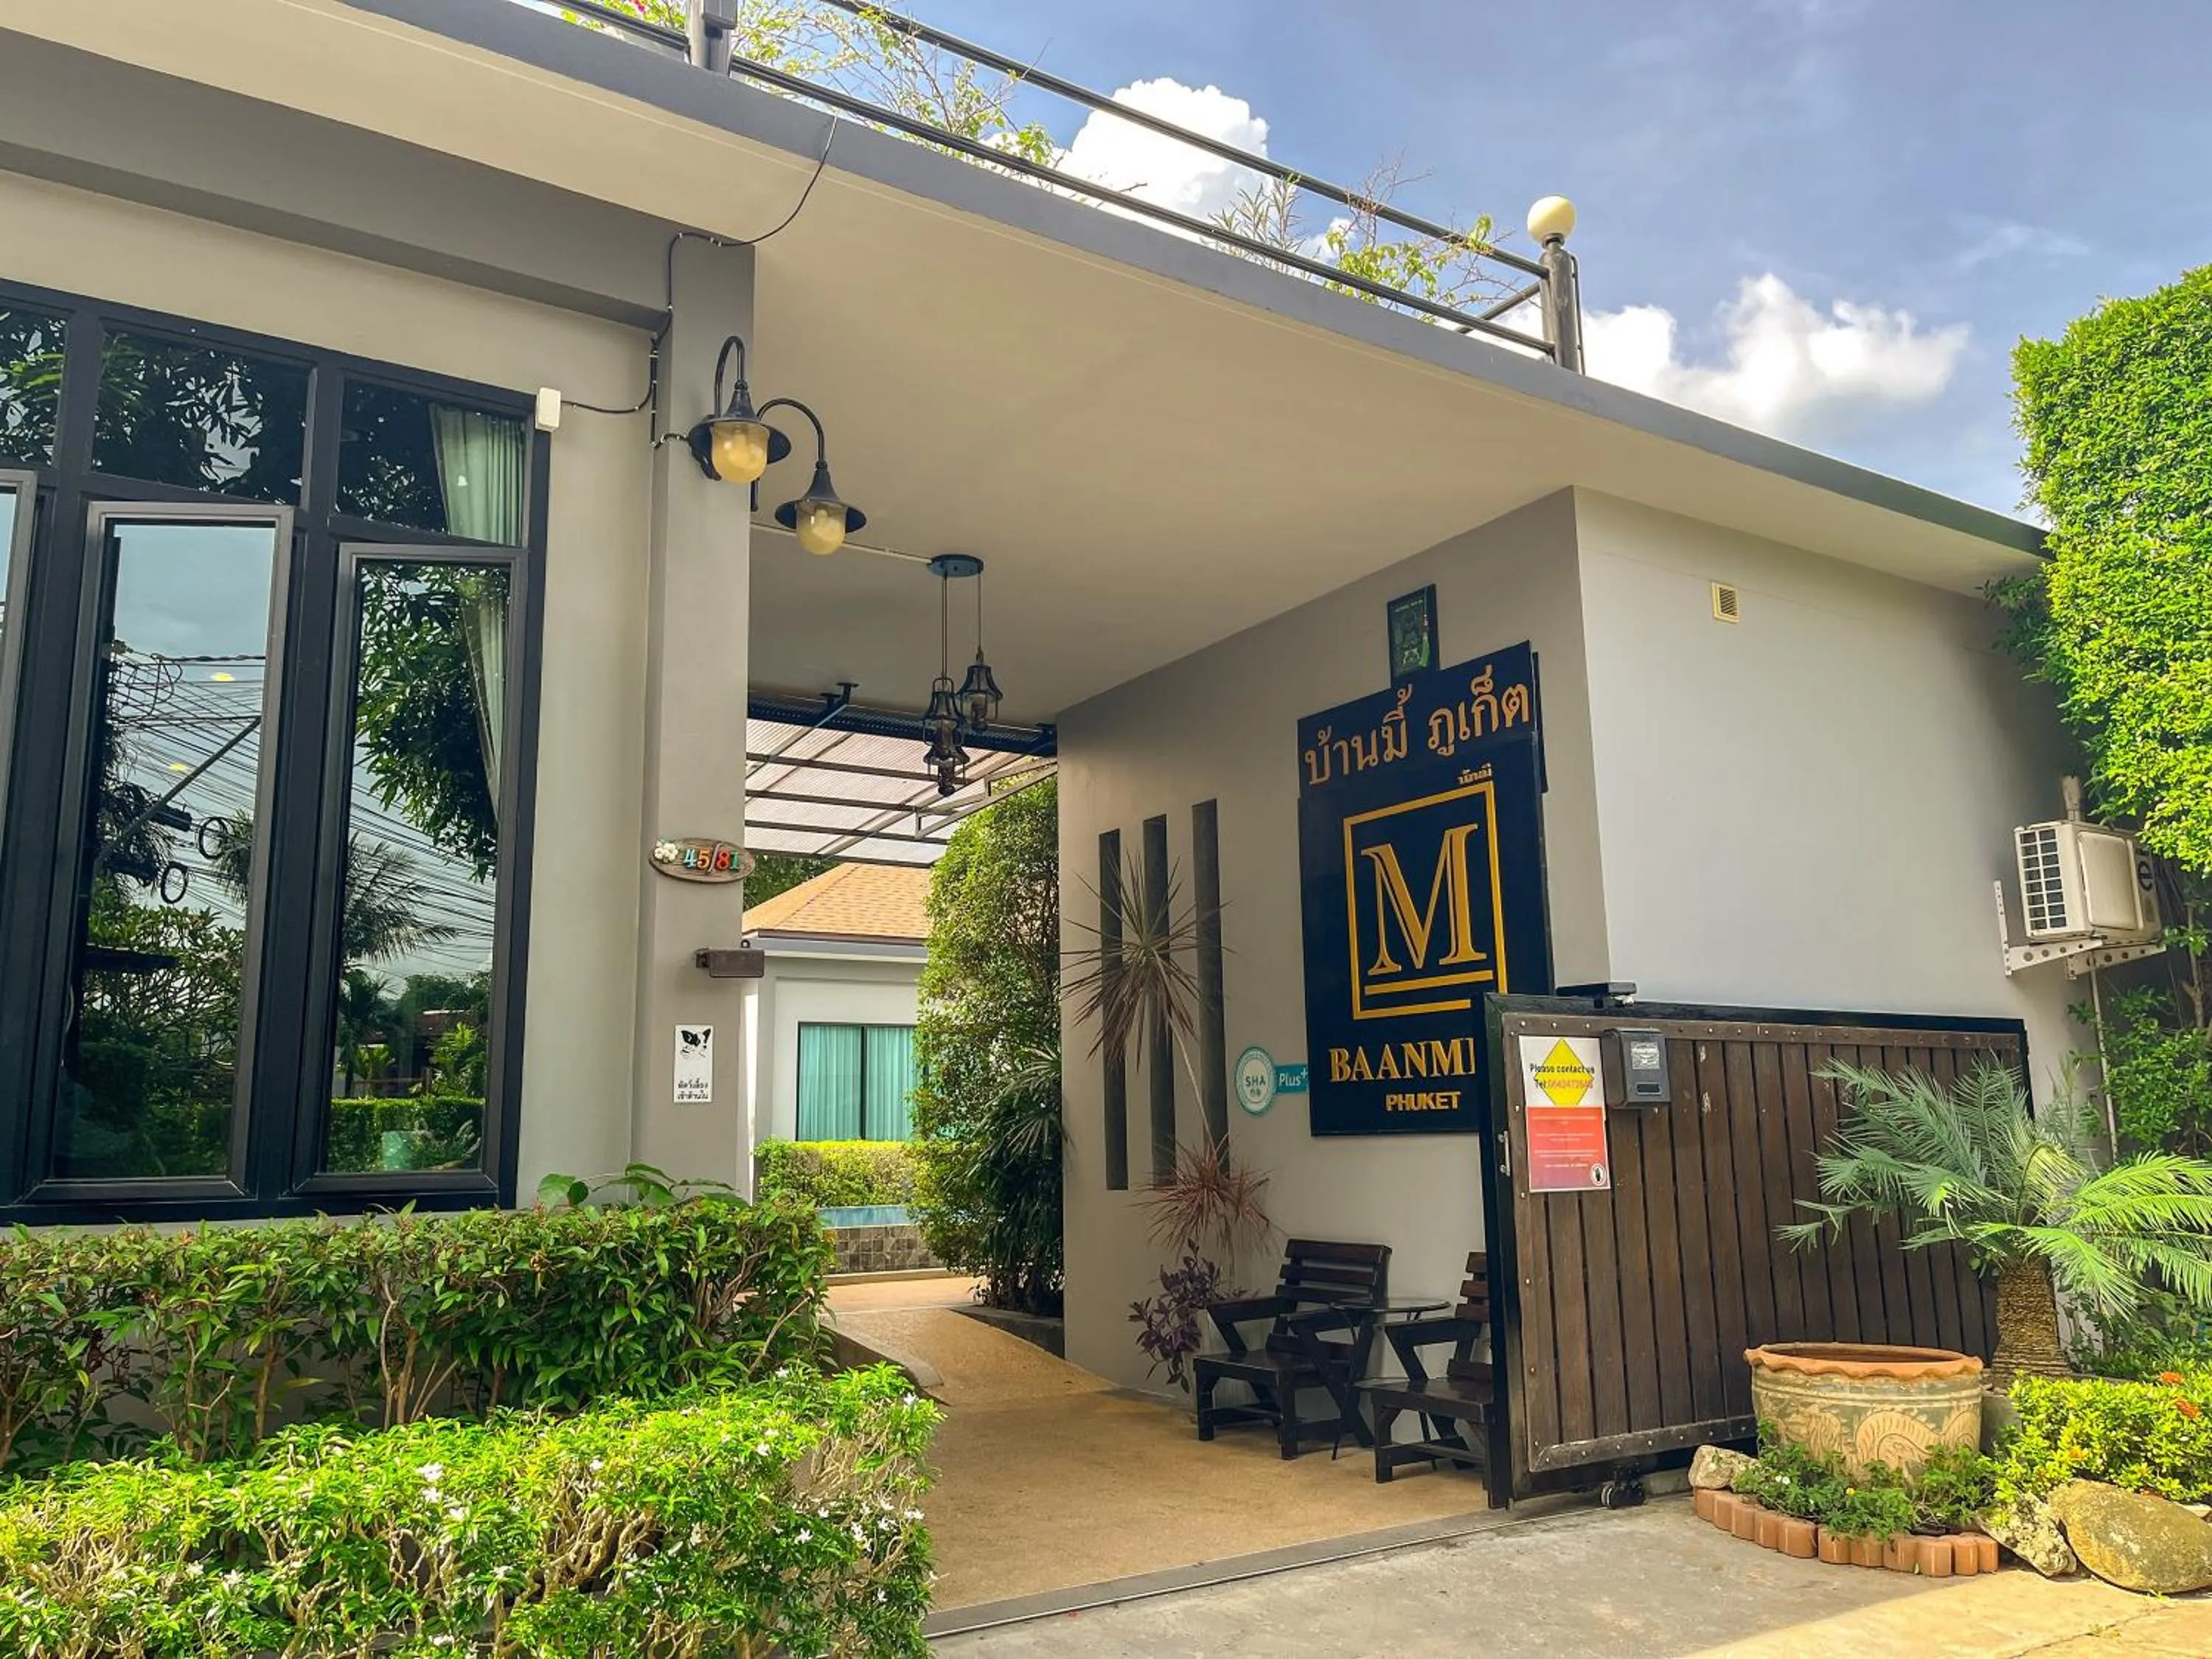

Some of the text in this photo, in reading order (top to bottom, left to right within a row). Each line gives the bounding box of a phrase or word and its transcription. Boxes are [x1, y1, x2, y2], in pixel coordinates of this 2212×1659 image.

[1304, 664, 1530, 786] บ้านมี้ ภูเก็ต
[684, 843, 740, 873] 45/81
[1361, 824, 1486, 975] M
[1245, 1075, 1266, 1087] SHA
[1385, 1091, 1461, 1111] PHUKET
